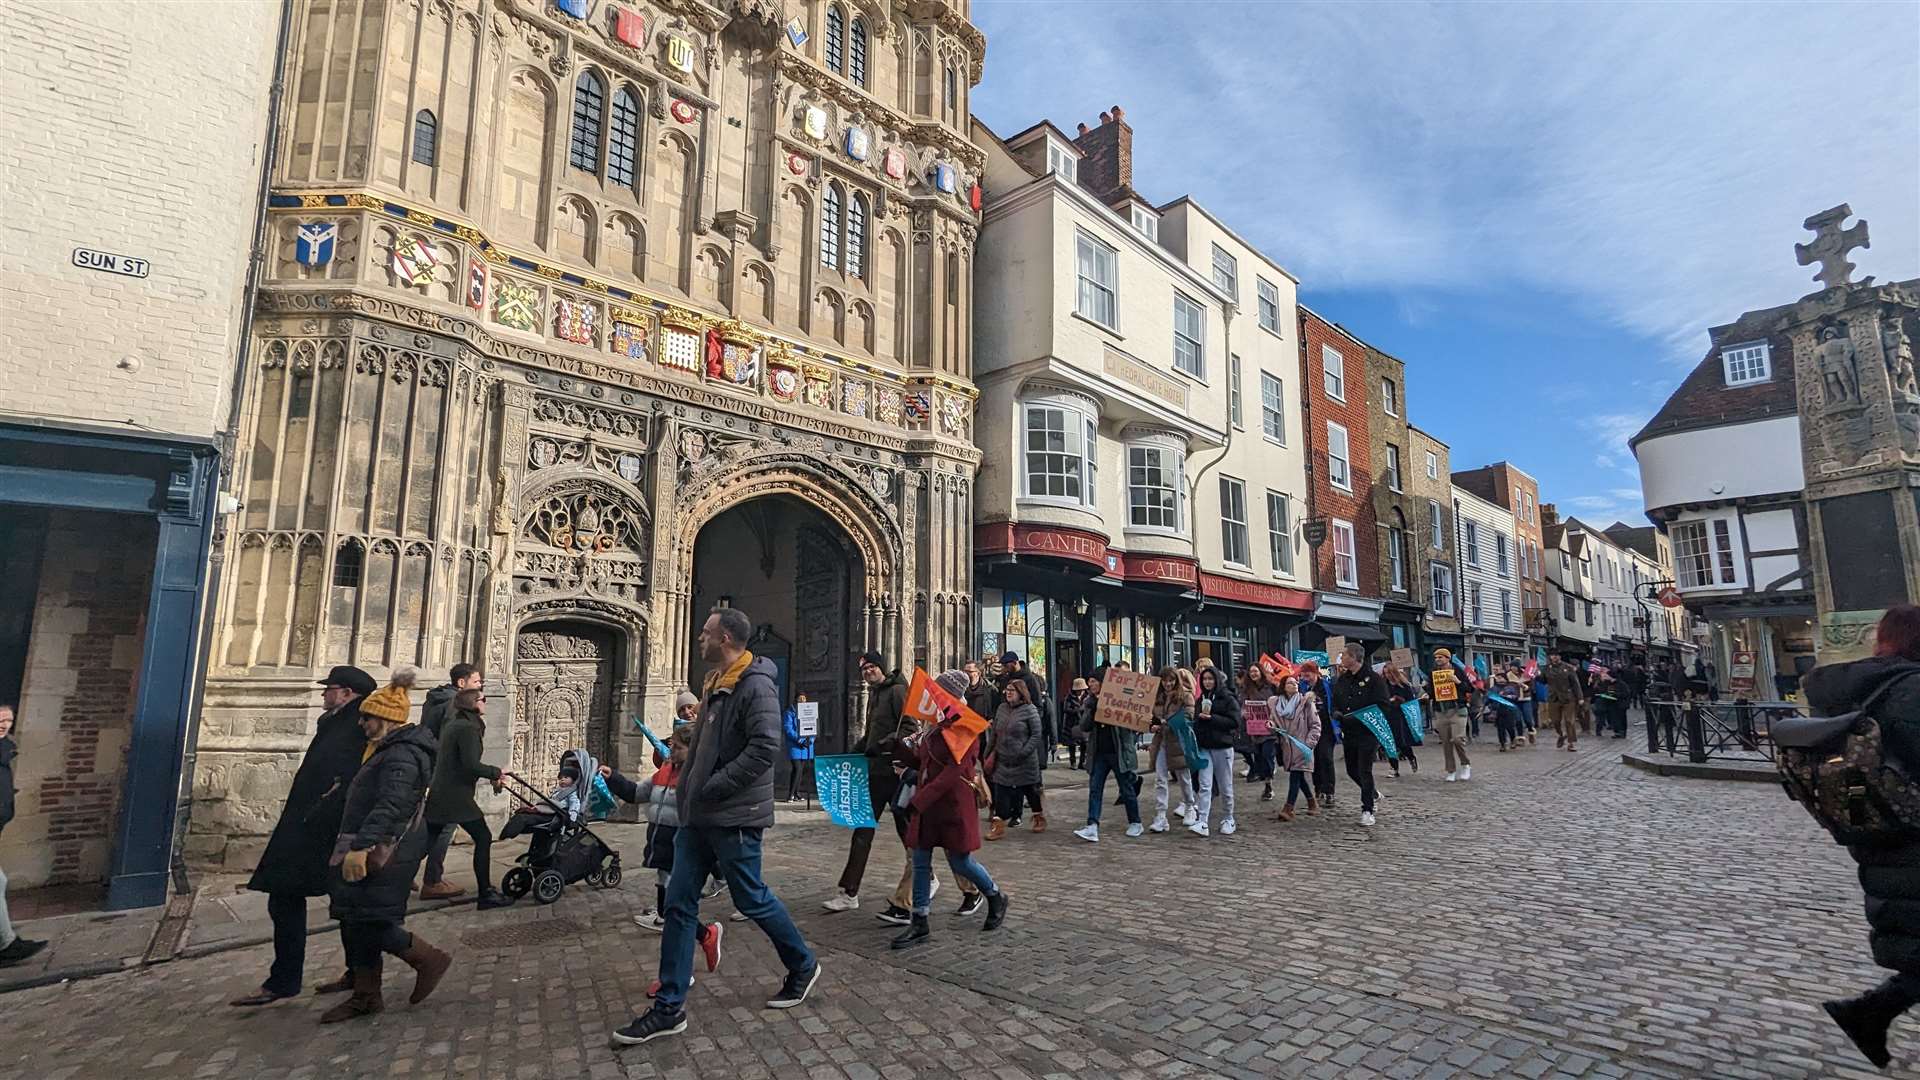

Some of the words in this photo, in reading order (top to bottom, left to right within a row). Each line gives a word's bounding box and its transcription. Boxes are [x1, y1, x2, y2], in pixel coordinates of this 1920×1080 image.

[79, 251, 115, 269] SUN
[123, 259, 146, 275] ST.
[1201, 577, 1234, 594] VISITOR
[1235, 583, 1262, 598] CENTRE
[1104, 708, 1143, 726] STAY
